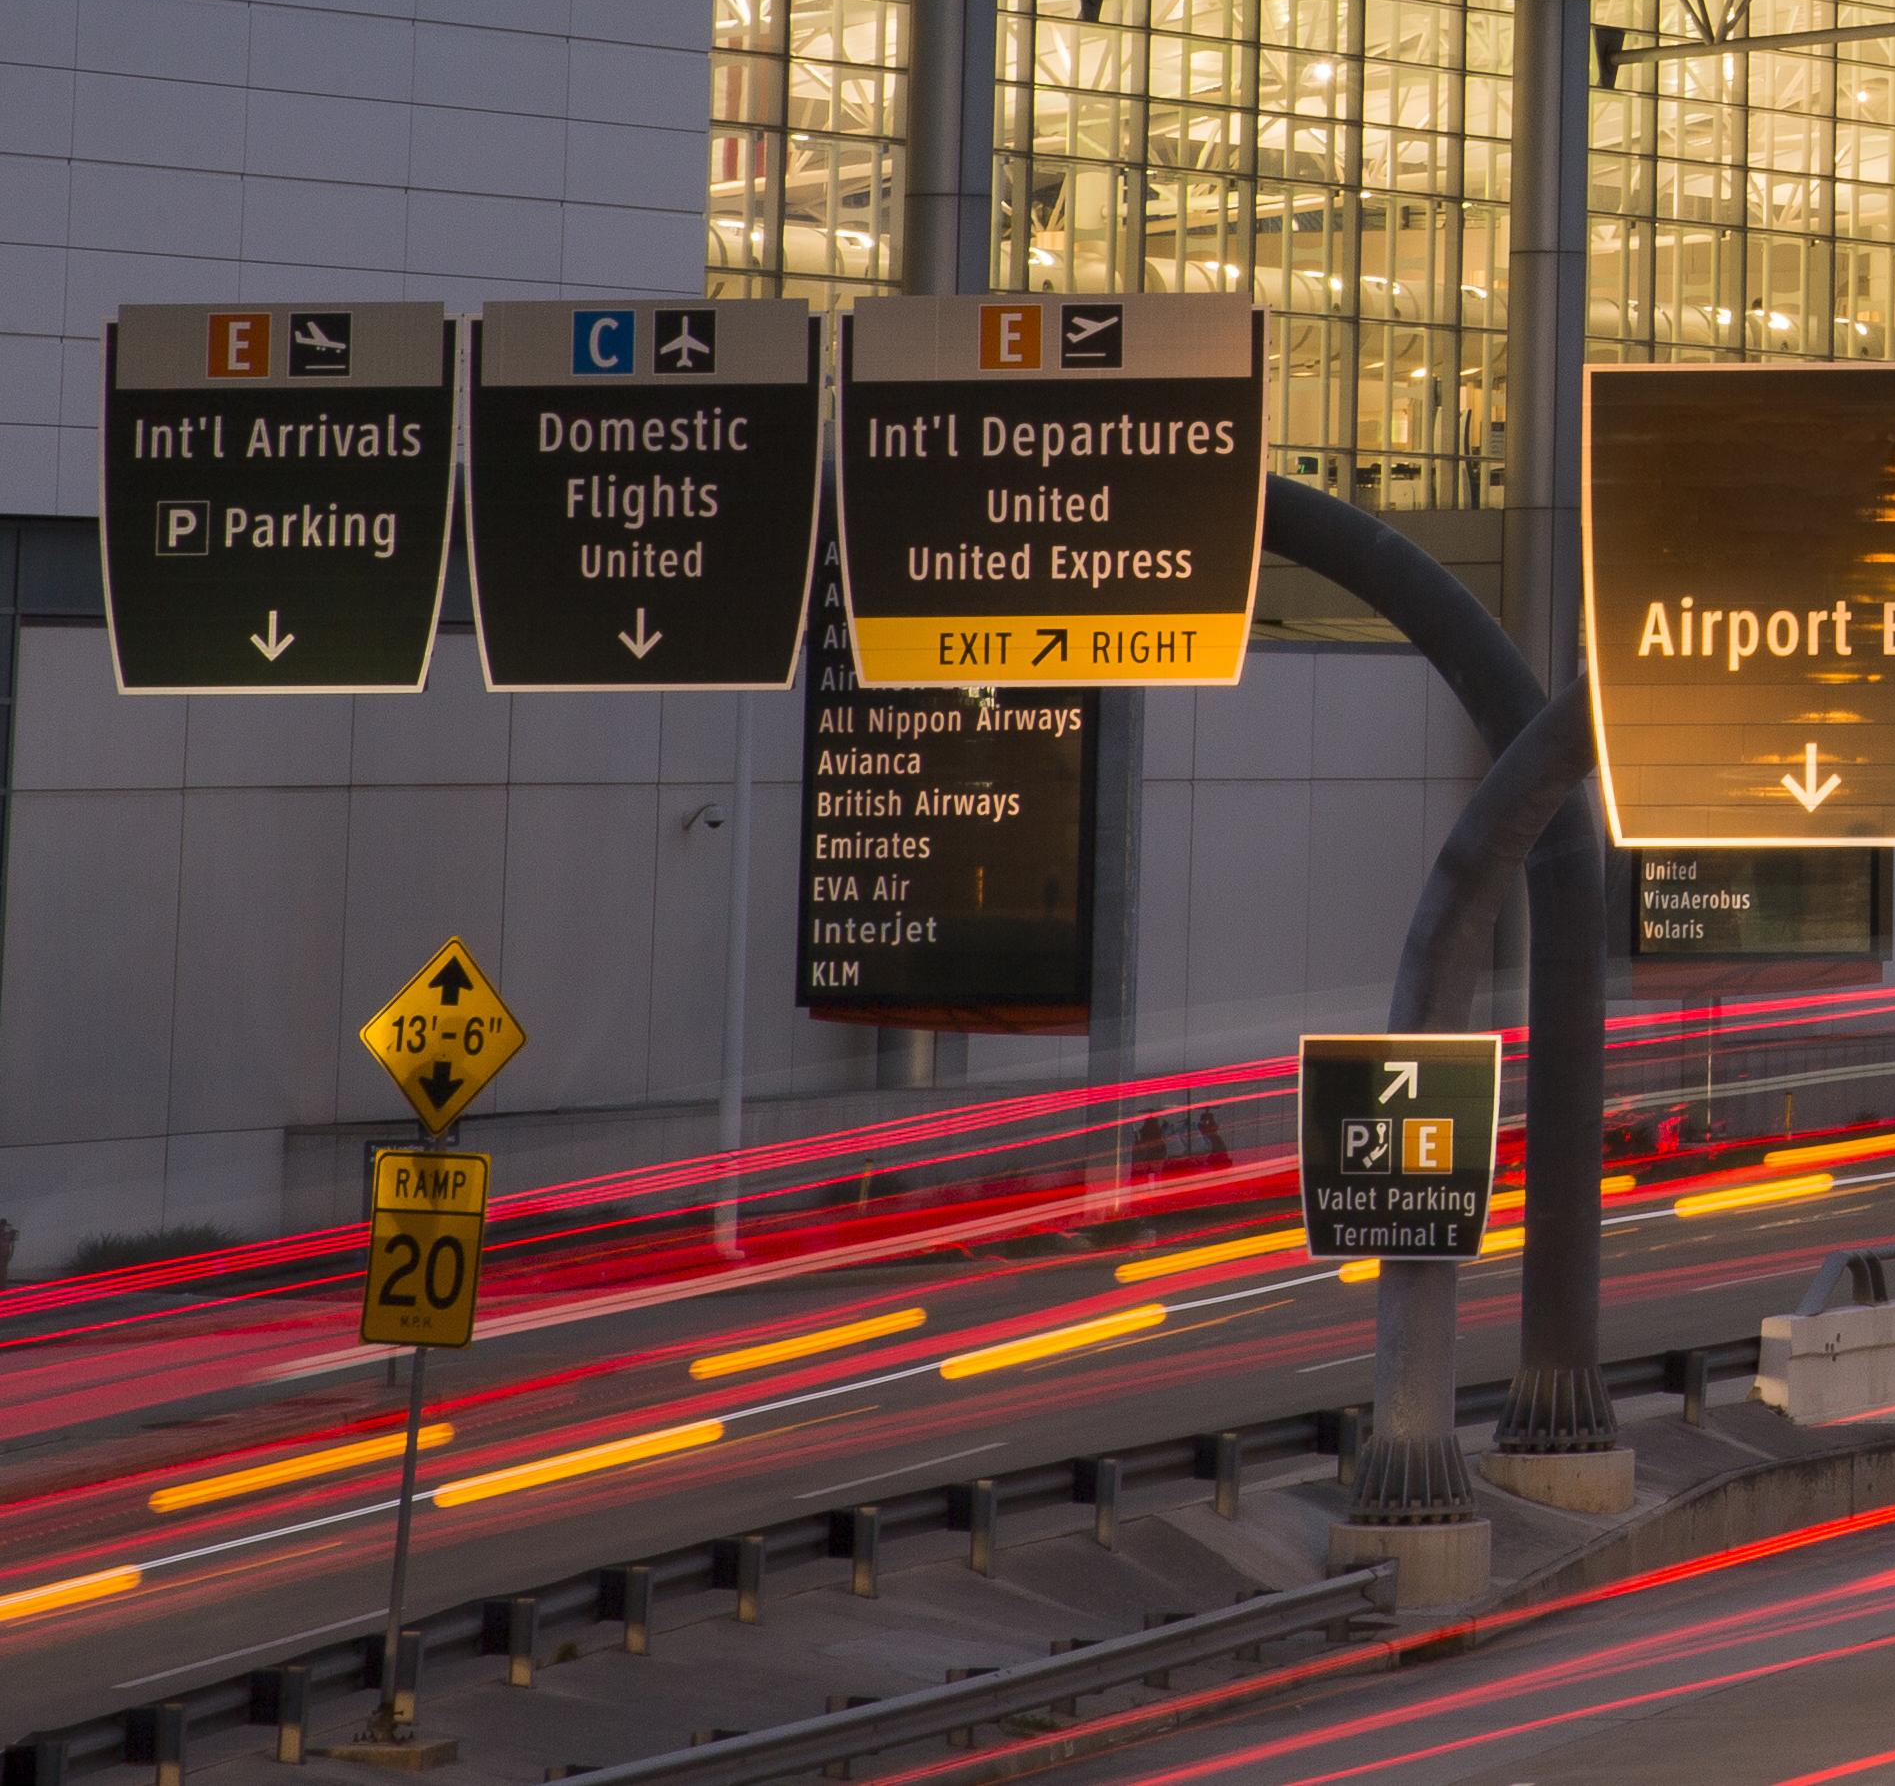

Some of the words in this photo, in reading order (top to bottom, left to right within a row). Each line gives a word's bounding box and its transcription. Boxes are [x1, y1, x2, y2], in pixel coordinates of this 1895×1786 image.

[227, 321, 251, 370] E
[589, 317, 618, 368] C
[1000, 313, 1023, 362] E
[135, 416, 224, 458] Int'l
[247, 414, 422, 458] Arrivals
[540, 407, 748, 452] Domestic
[869, 415, 958, 458] Int'l
[982, 414, 1236, 467] Departures
[567, 474, 719, 529] Flights
[987, 486, 1110, 523] United
[168, 510, 196, 547] P
[225, 504, 397, 558] Parking
[581, 541, 703, 578] United
[908, 543, 1031, 581] United
[1051, 545, 1193, 588] Express
[940, 632, 1012, 666] EXIT
[1092, 630, 1198, 664] RIGHT
[1637, 596, 1853, 673] Airport
[819, 707, 854, 734] All
[869, 705, 962, 740] Nippon
[976, 703, 1083, 738] Airways
[817, 747, 922, 776] Avianca
[817, 789, 901, 817] British
[915, 787, 1020, 823] Airways
[815, 831, 931, 859] Emirates
[813, 876, 860, 902] EVA
[873, 873, 911, 902] Air
[1645, 860, 1697, 881] United
[1643, 890, 1751, 910] VivaAerobus
[813, 911, 938, 946] Interjet
[1643, 919, 1704, 940] Volaris
[811, 961, 860, 987] KLM
[1346, 1125, 1369, 1158] P
[1419, 1125, 1438, 1168] E
[395, 1167, 467, 1201] RAMP
[1317, 1186, 1377, 1211] Valet
[1388, 1186, 1476, 1217] Parking
[1333, 1222, 1436, 1247] Terminal
[1448, 1224, 1459, 1247] E
[379, 1233, 465, 1309] 20
